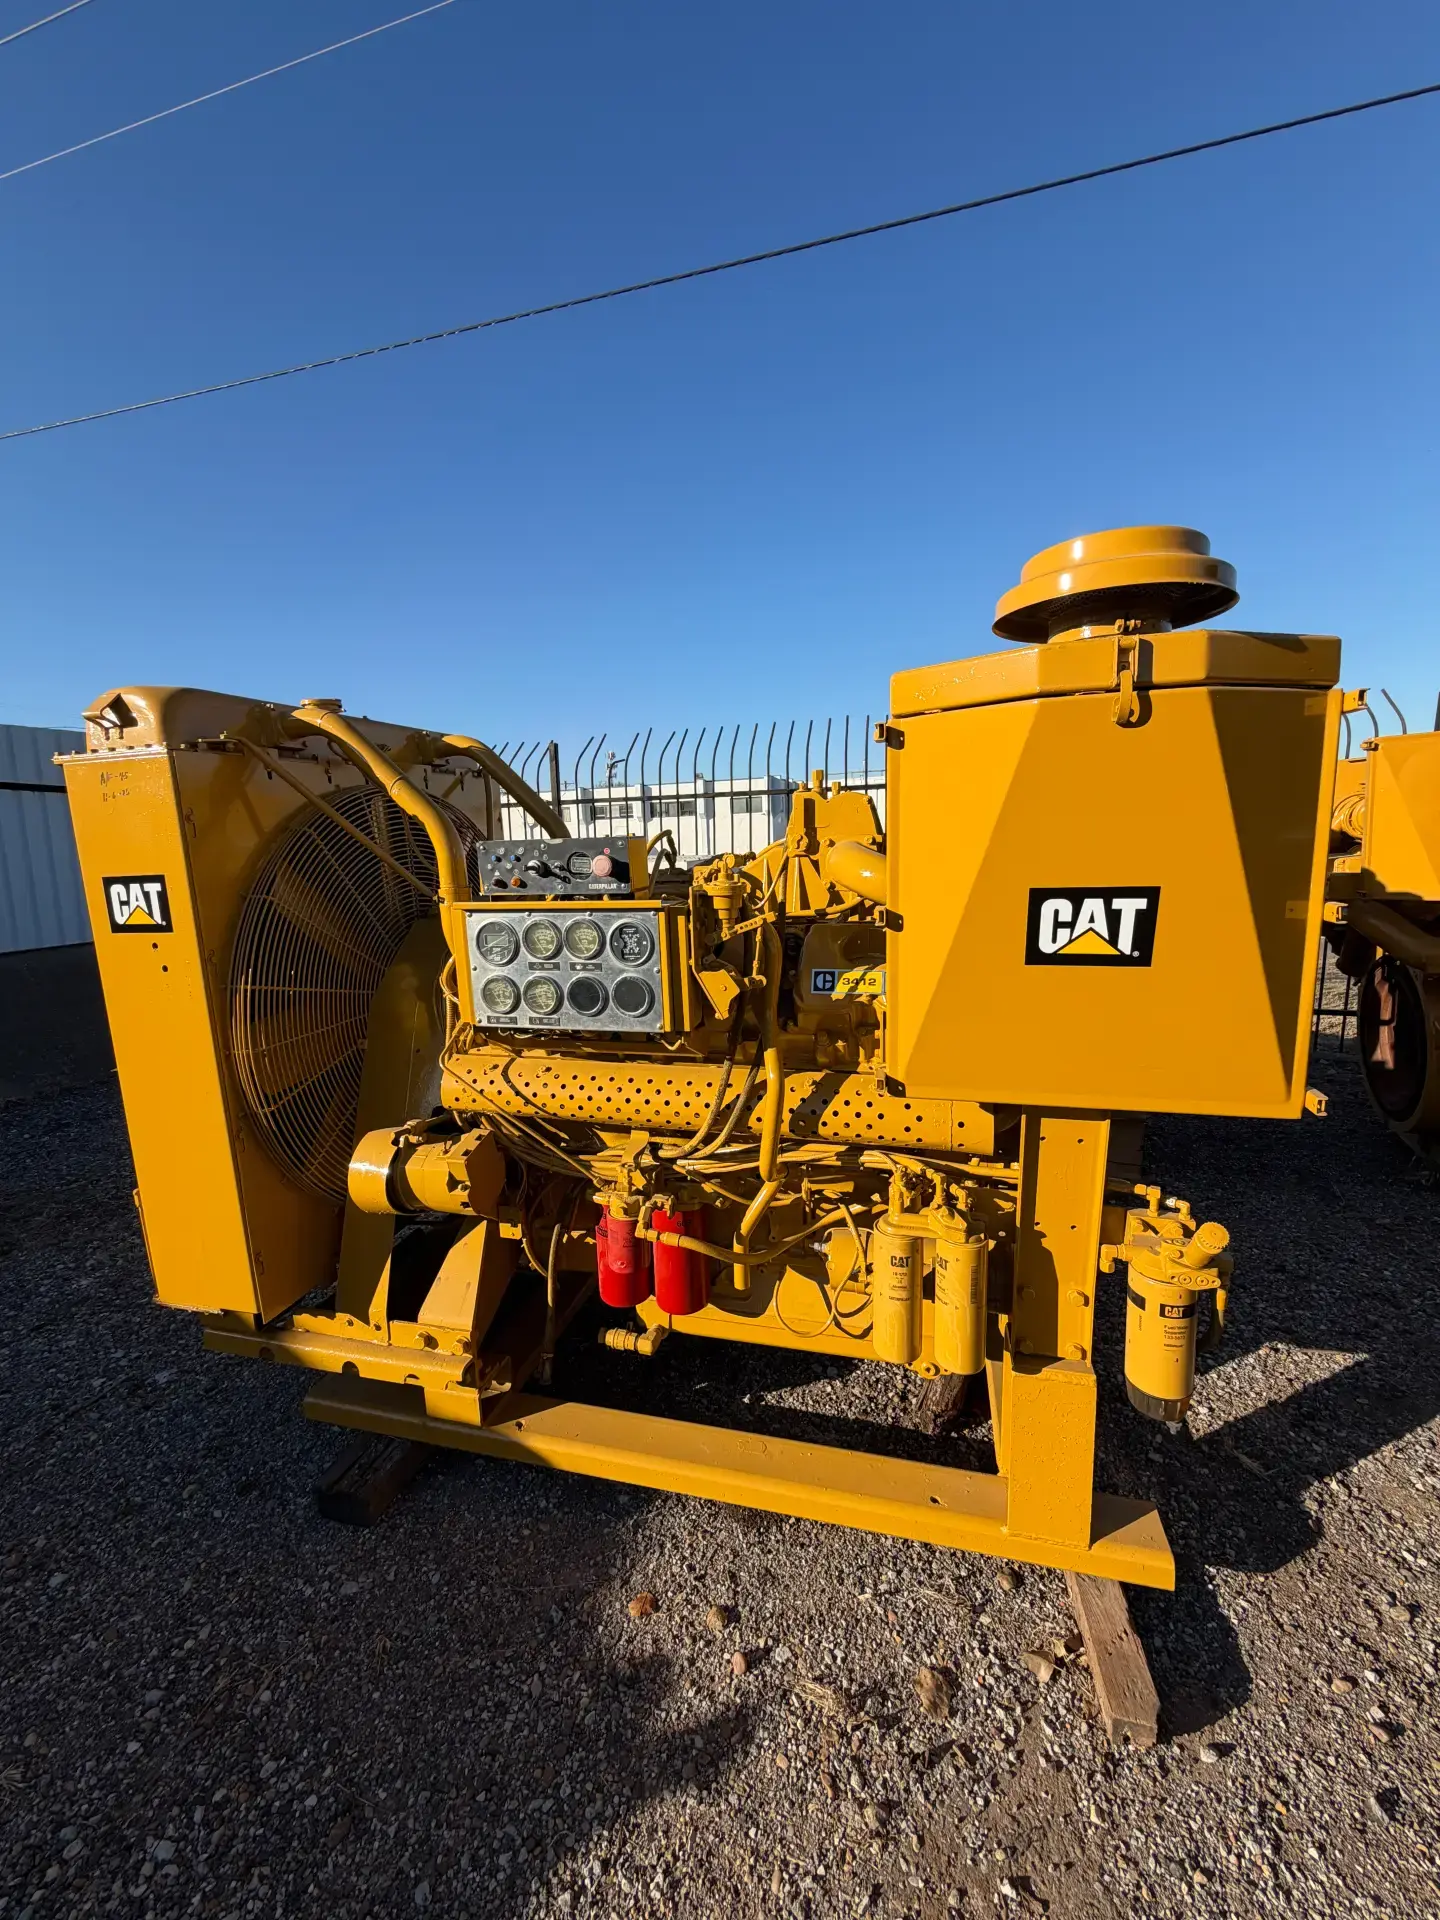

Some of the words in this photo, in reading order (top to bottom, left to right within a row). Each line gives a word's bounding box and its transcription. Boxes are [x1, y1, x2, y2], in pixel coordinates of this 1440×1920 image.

[110, 882, 162, 925] CAT
[1038, 898, 1148, 956] CAT
[842, 977, 877, 986] 3412
[890, 1255, 911, 1268] CAT
[1165, 1306, 1184, 1318] CAT
